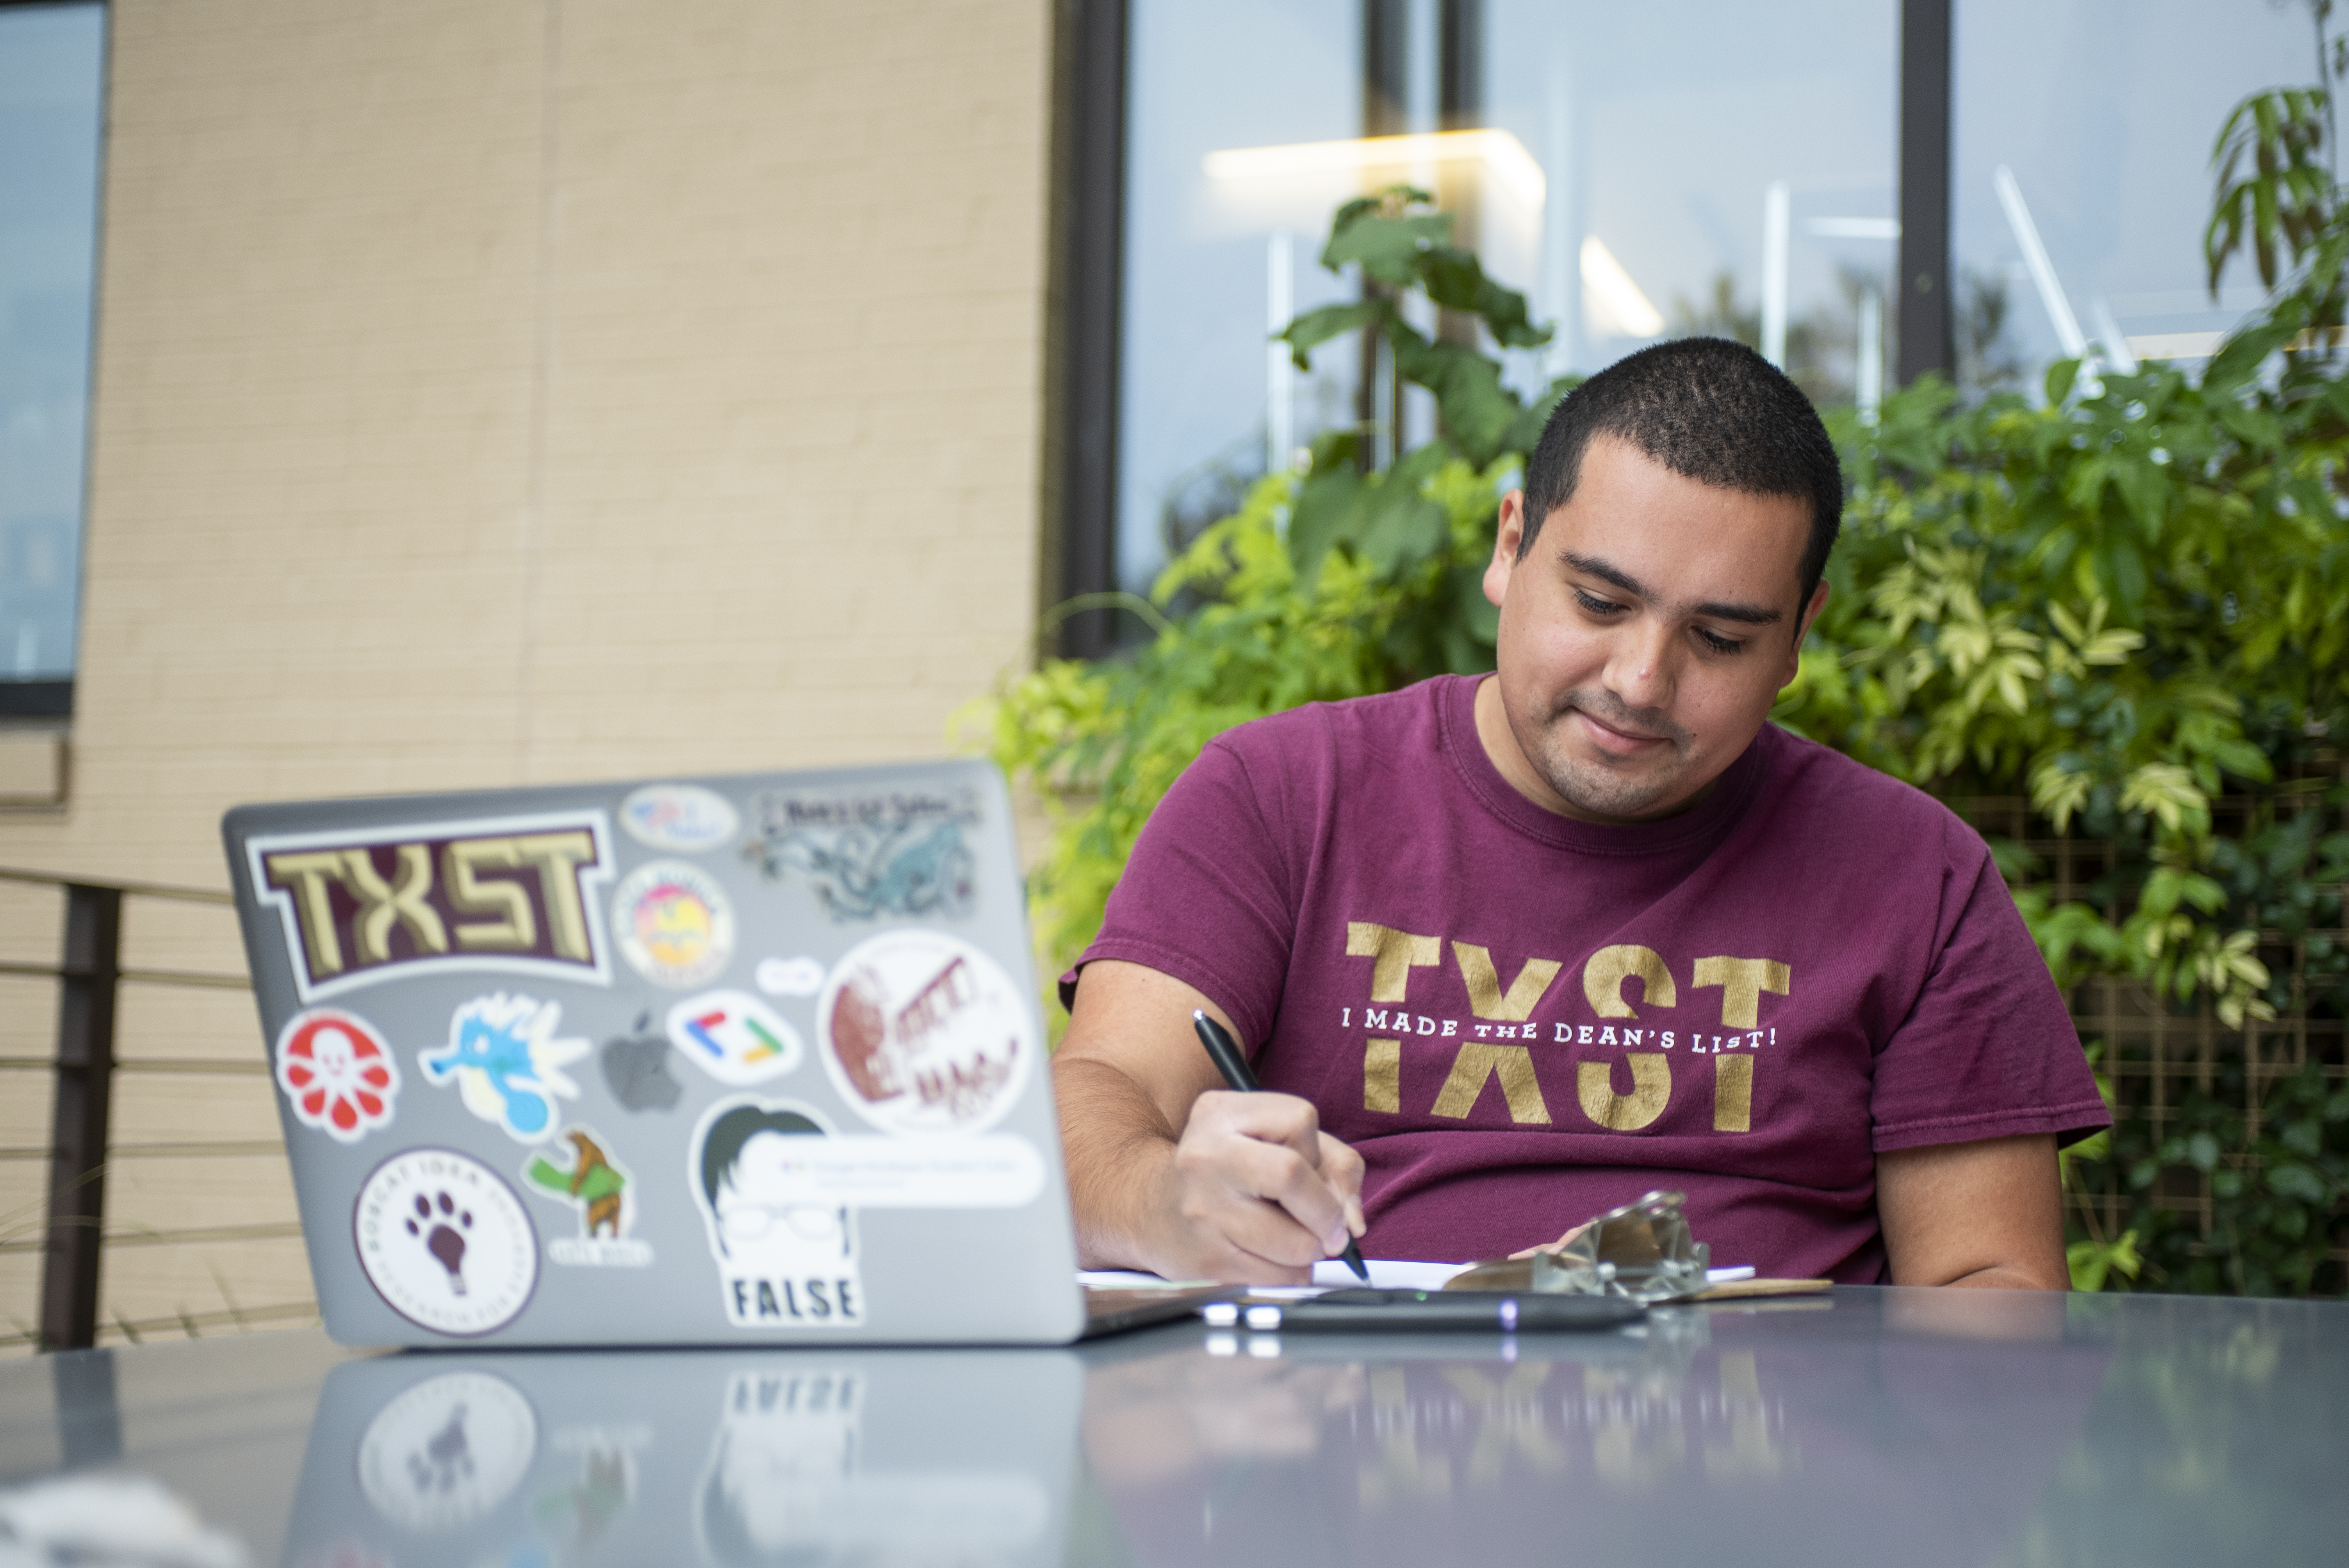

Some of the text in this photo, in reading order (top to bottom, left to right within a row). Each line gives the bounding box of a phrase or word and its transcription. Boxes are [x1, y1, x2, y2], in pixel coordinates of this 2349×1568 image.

[267, 831, 595, 977] TXST
[1342, 1007, 1776, 1054] I MADE THE DEAN'S LIST!
[1346, 922, 1791, 1132] TXST
[366, 1160, 478, 1251] BOBCAT IDEA
[733, 1279, 857, 1318] FALSE
